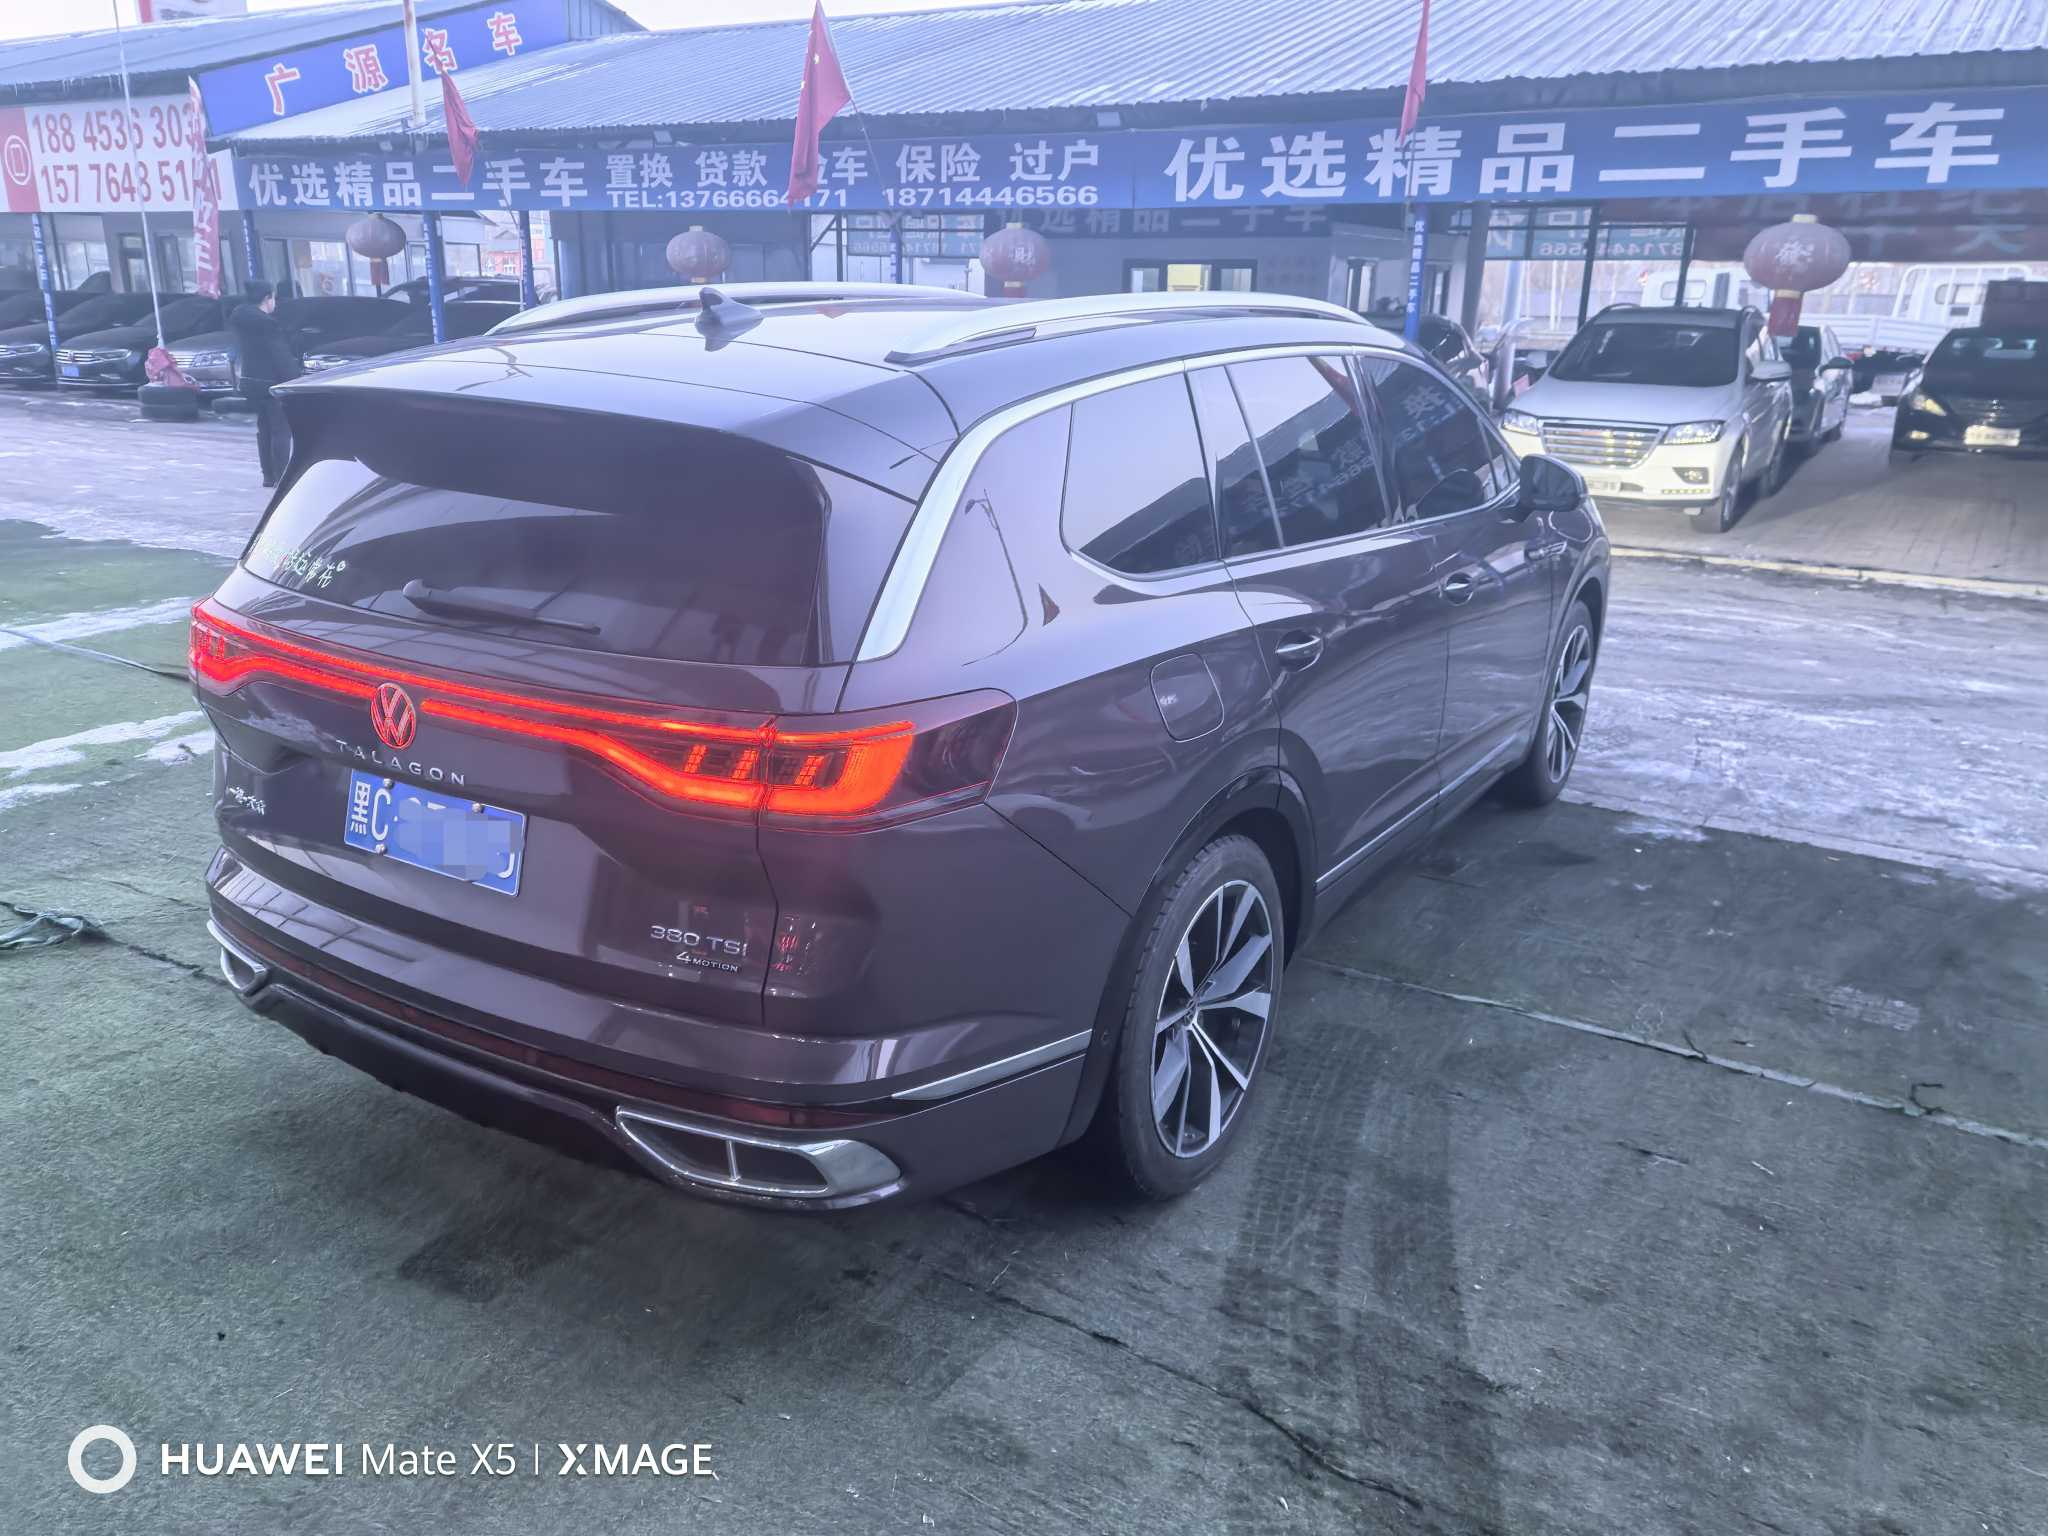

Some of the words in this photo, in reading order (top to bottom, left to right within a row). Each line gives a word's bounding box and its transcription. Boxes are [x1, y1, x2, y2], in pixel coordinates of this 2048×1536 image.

[264, 11, 522, 116] 广源名车
[32, 112, 75, 153] 188
[1163, 100, 2006, 203] 优选精品二手车
[41, 164, 79, 203] 157
[249, 156, 588, 207] 优选精品二手车
[605, 152, 673, 189] 置换
[695, 150, 768, 188] 贷款
[896, 142, 982, 184] 保险
[1009, 138, 1099, 182] 过户
[883, 185, 1099, 207] 18714446566
[335, 738, 466, 788] TALAGON
[650, 924, 700, 947] 380
[706, 935, 749, 958] TSI
